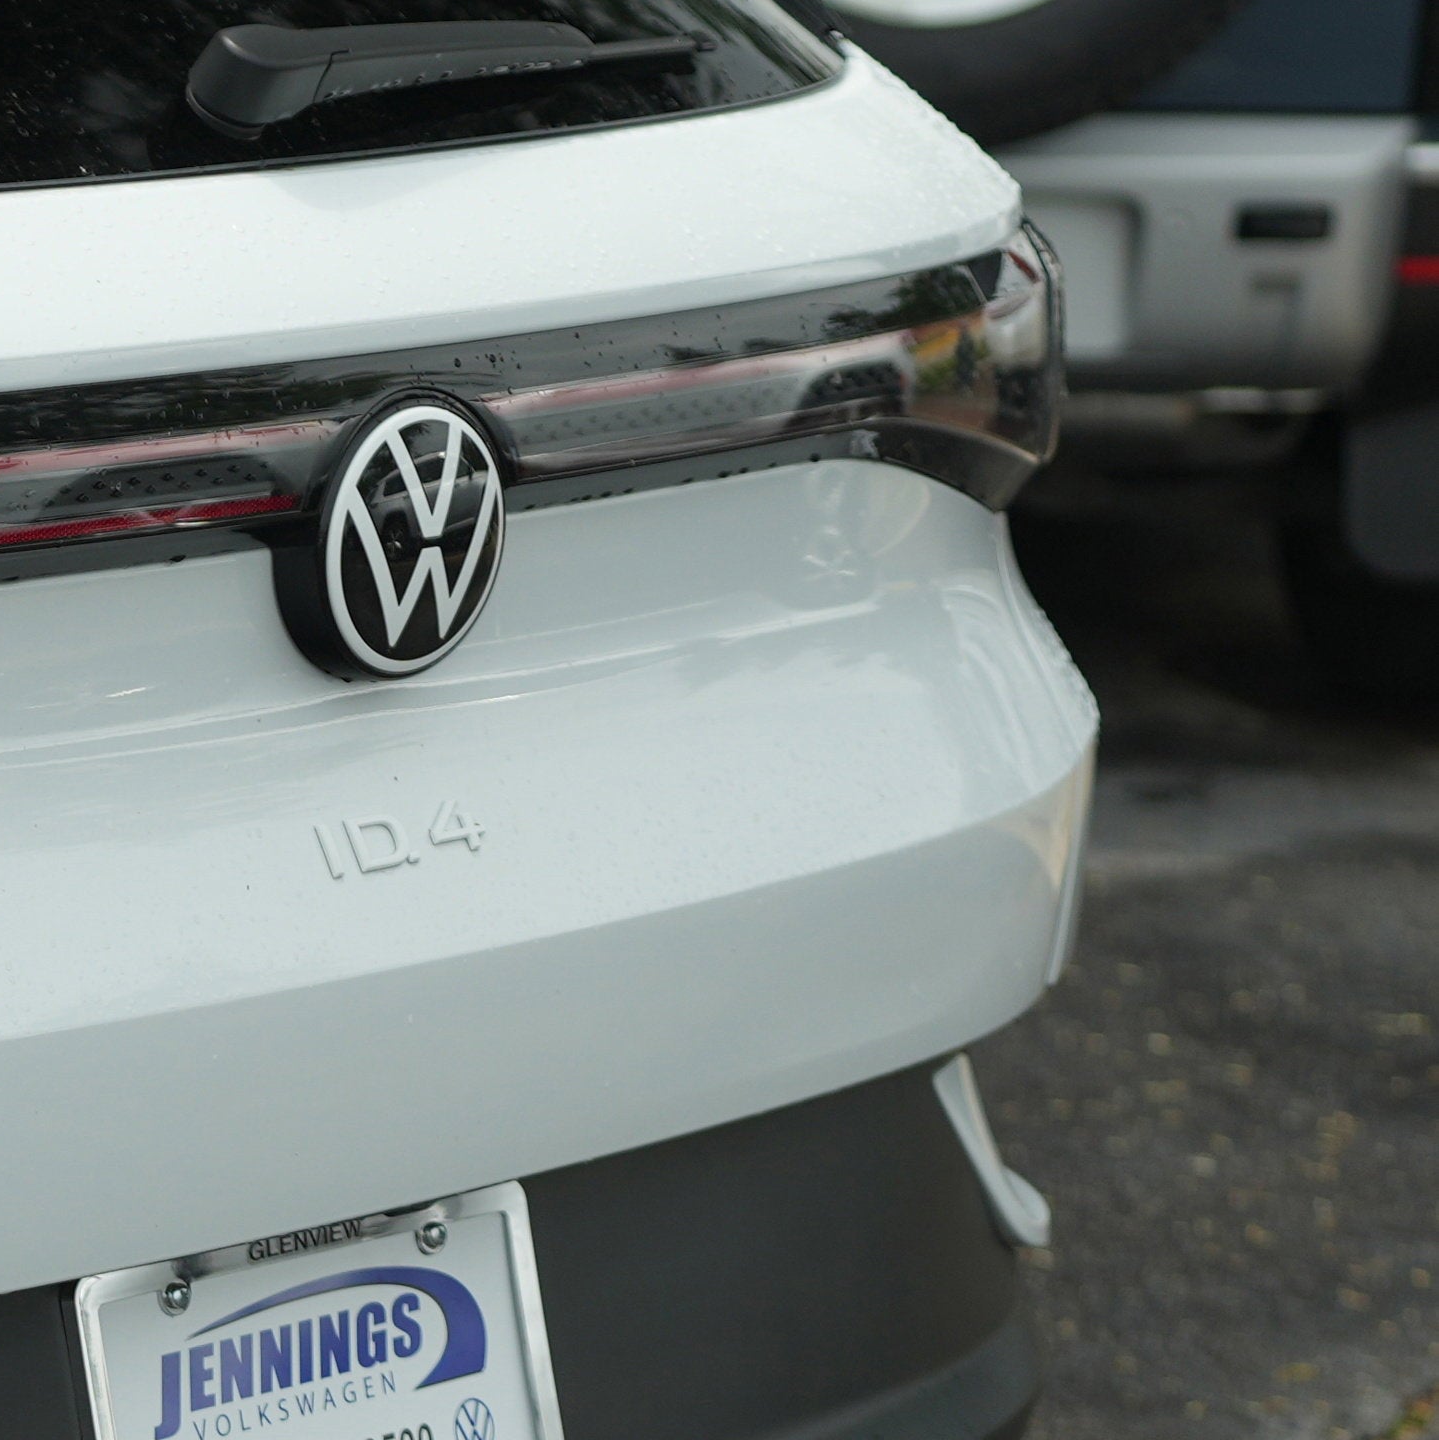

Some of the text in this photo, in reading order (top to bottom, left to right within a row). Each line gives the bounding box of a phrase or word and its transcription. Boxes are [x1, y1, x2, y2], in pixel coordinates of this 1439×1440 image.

[326, 405, 505, 673] VW
[314, 799, 485, 880] ID.4
[248, 1217, 363, 1261] GLENVIEW
